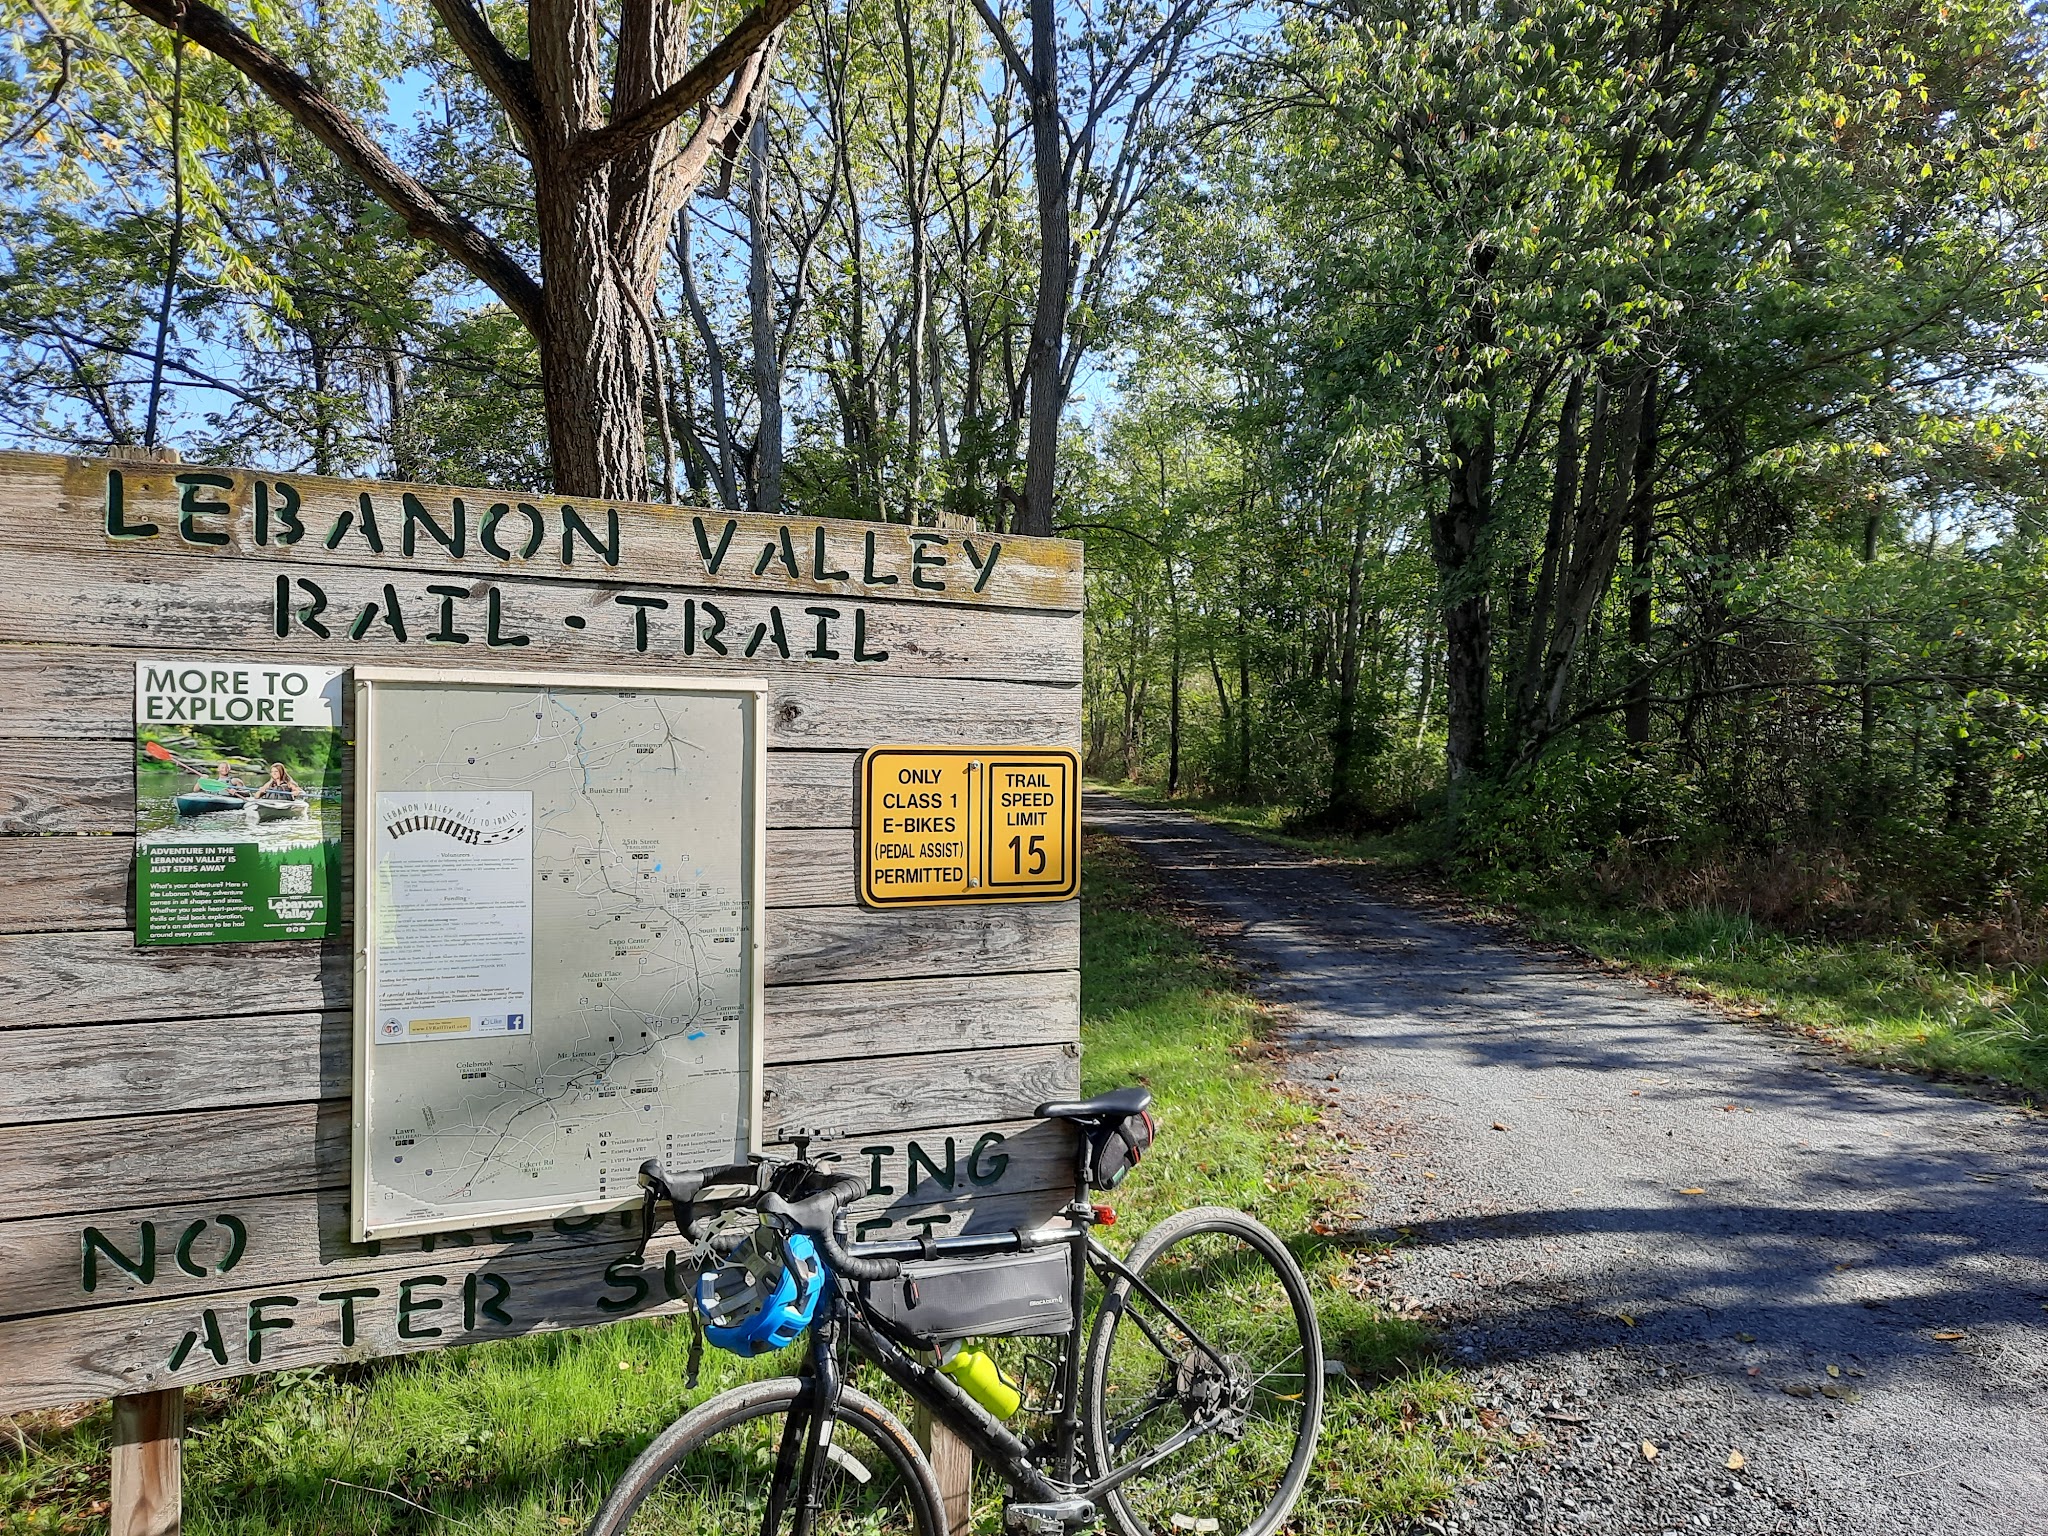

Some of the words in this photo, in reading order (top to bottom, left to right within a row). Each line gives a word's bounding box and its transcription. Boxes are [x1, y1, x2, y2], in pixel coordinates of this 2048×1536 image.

[107, 469, 620, 567] LEBANON
[693, 517, 1001, 594] VALLEY
[274, 575, 530, 647] RAIL
[615, 596, 889, 664] TRAIL
[145, 669, 249, 695] MORE
[262, 672, 308, 696] TO
[146, 696, 294, 722] EXPLORE
[898, 769, 942, 784] ONLY
[1005, 774, 1050, 788] TRAIL
[883, 793, 942, 809] CLASS
[949, 793, 958, 809] 1
[1001, 793, 1054, 807] SPEED
[382, 803, 419, 822] LEBANON
[424, 802, 453, 815] VALLEY
[456, 811, 477, 825] RAILS
[481, 819, 489, 827] TO
[493, 809, 518, 826] TRAILS
[1007, 812, 1047, 826] LIMIT
[883, 817, 956, 833] E-BIKES
[150, 847, 203, 855] ADVENTURE
[875, 843, 916, 860] (PEDAL
[919, 840, 964, 858] ASSIST)
[1008, 835, 1047, 875] 15
[150, 856, 193, 864] LEBANON
[150, 865, 171, 873] JUST
[874, 867, 964, 884] PERMITTED
[268, 899, 324, 909] Lebanon
[276, 909, 314, 920] Valley
[456, 1061, 494, 1069] Colebrook
[81, 1214, 248, 1292] NO
[1029, 1298, 1058, 1307] Blackburn
[166, 1272, 513, 1371] AFTER
